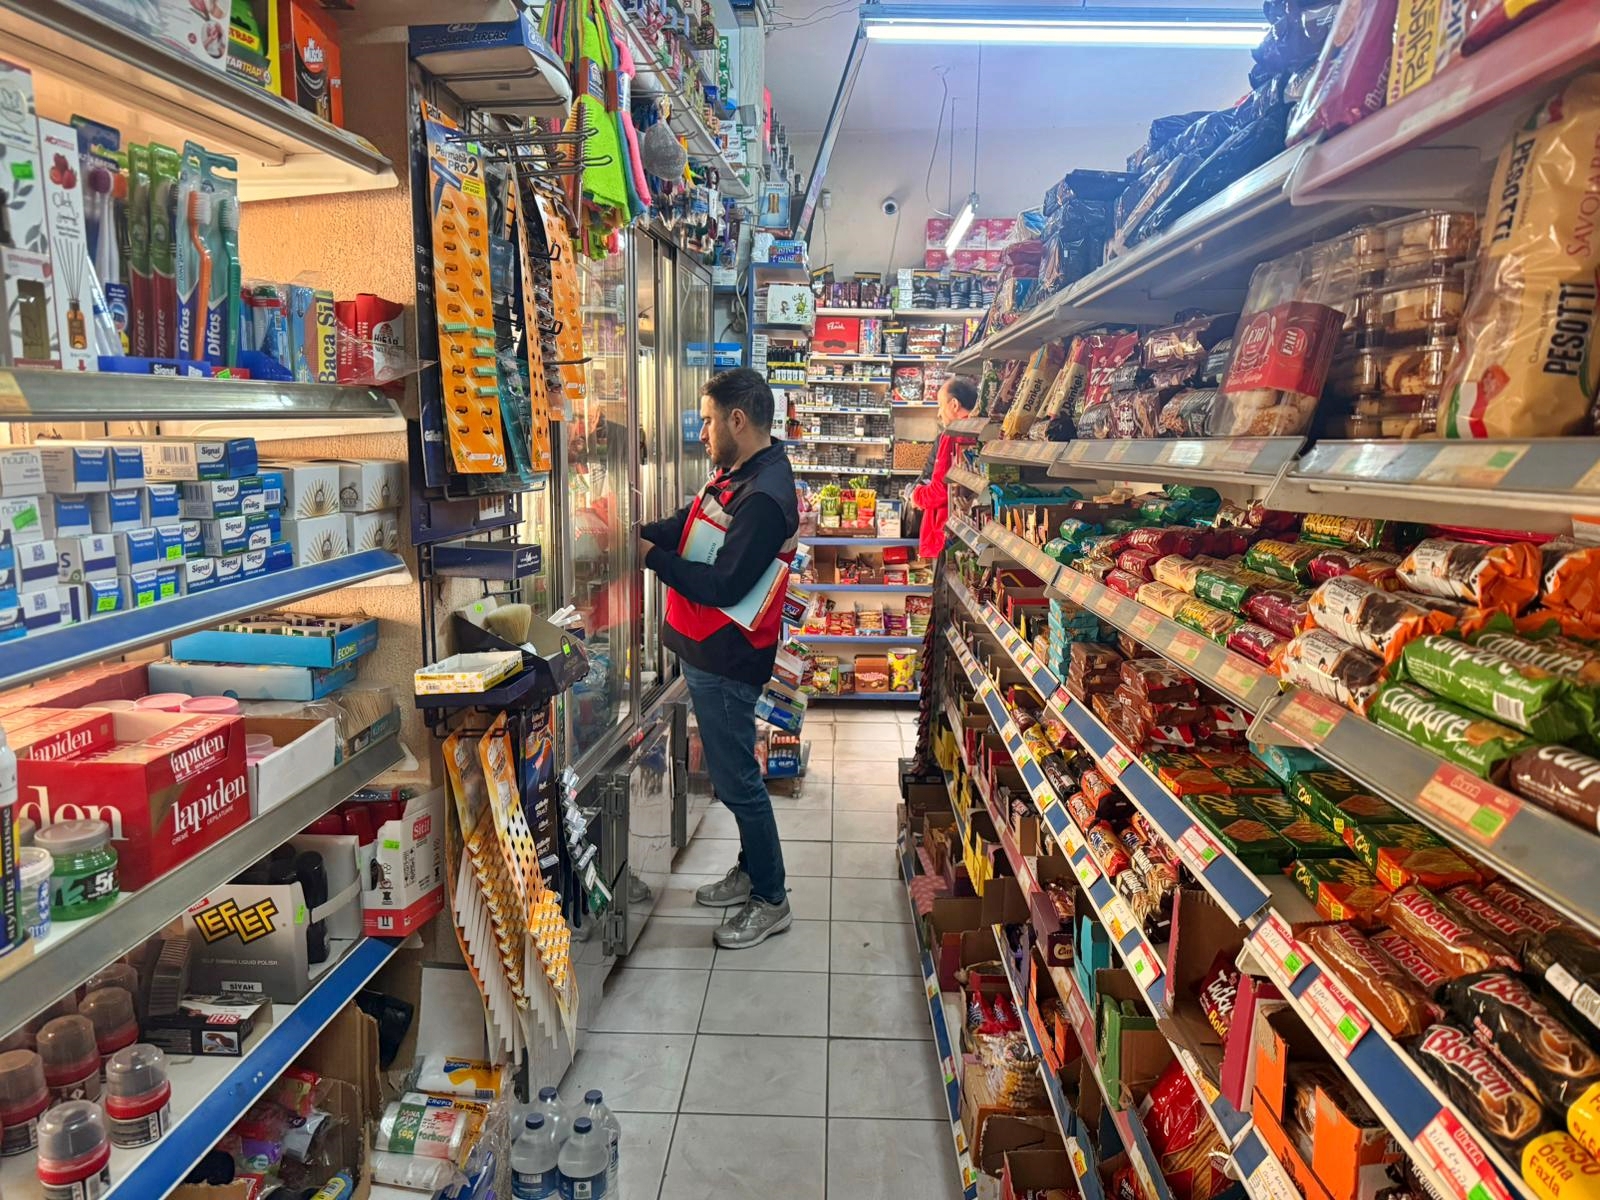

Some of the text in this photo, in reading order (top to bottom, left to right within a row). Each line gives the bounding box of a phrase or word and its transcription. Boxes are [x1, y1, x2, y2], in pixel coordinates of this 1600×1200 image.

[448, 160, 468, 175] PRO
[207, 313, 221, 356] Difas
[1543, 282, 1596, 376] PESOTTI
[1023, 377, 1044, 412] Dankek
[201, 446, 221, 457] Signal
[217, 483, 235, 494] Signal
[225, 521, 242, 532] Signal
[192, 563, 210, 574] Signal
[221, 558, 238, 569] Signal
[246, 552, 263, 563] Signal
[171, 775, 248, 836] lapiden
[3, 808, 15, 874] mousse
[1393, 892, 1474, 944] Albeni
[1420, 1024, 1516, 1101] Biskrem
[1529, 1155, 1561, 1198] Fazla
[1538, 1144, 1574, 1182] Daha
